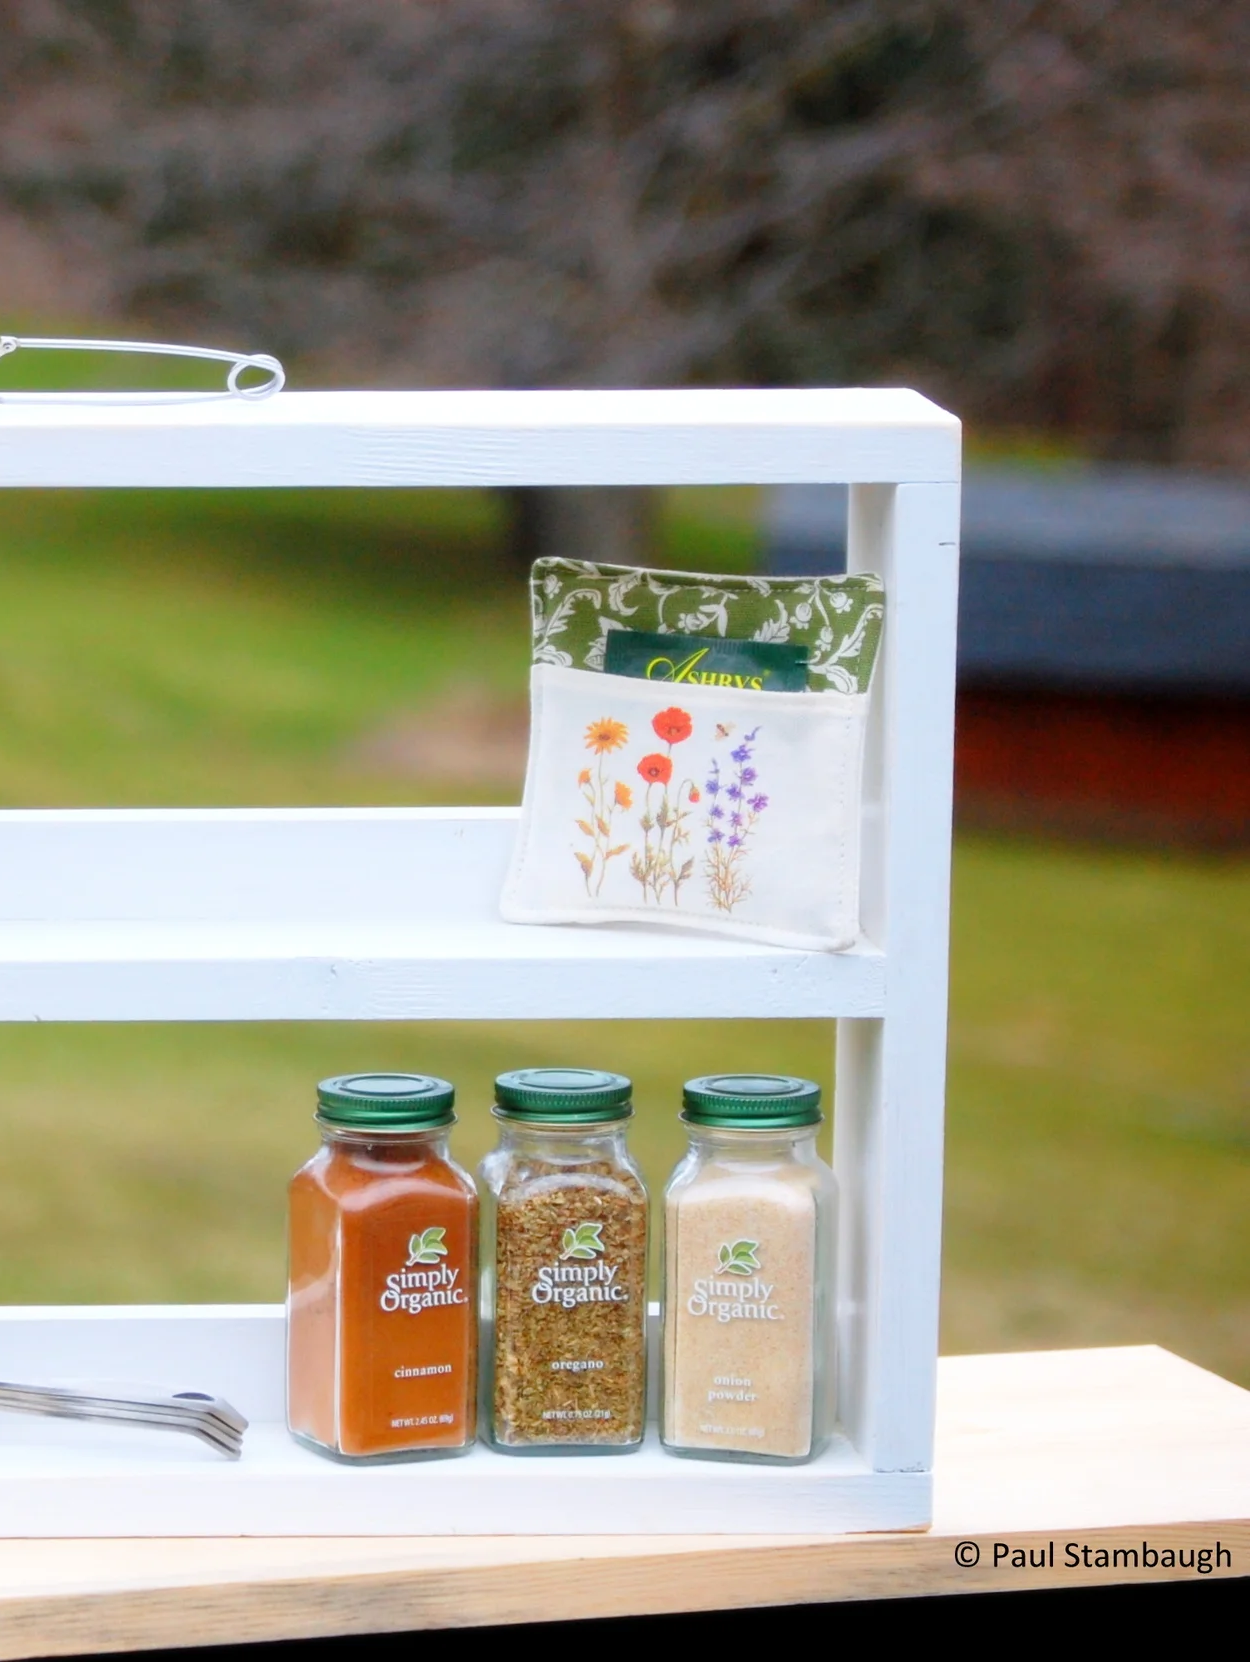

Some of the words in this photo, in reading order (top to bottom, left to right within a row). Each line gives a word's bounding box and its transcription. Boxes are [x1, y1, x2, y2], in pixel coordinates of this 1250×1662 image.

[386, 1263, 459, 1297] Simply
[538, 1259, 618, 1291] Simply
[694, 1275, 774, 1304] Simply
[394, 1364, 452, 1378] cinnamon
[551, 1360, 604, 1373] oregano
[713, 1374, 752, 1387] onion
[708, 1390, 759, 1403] powder
